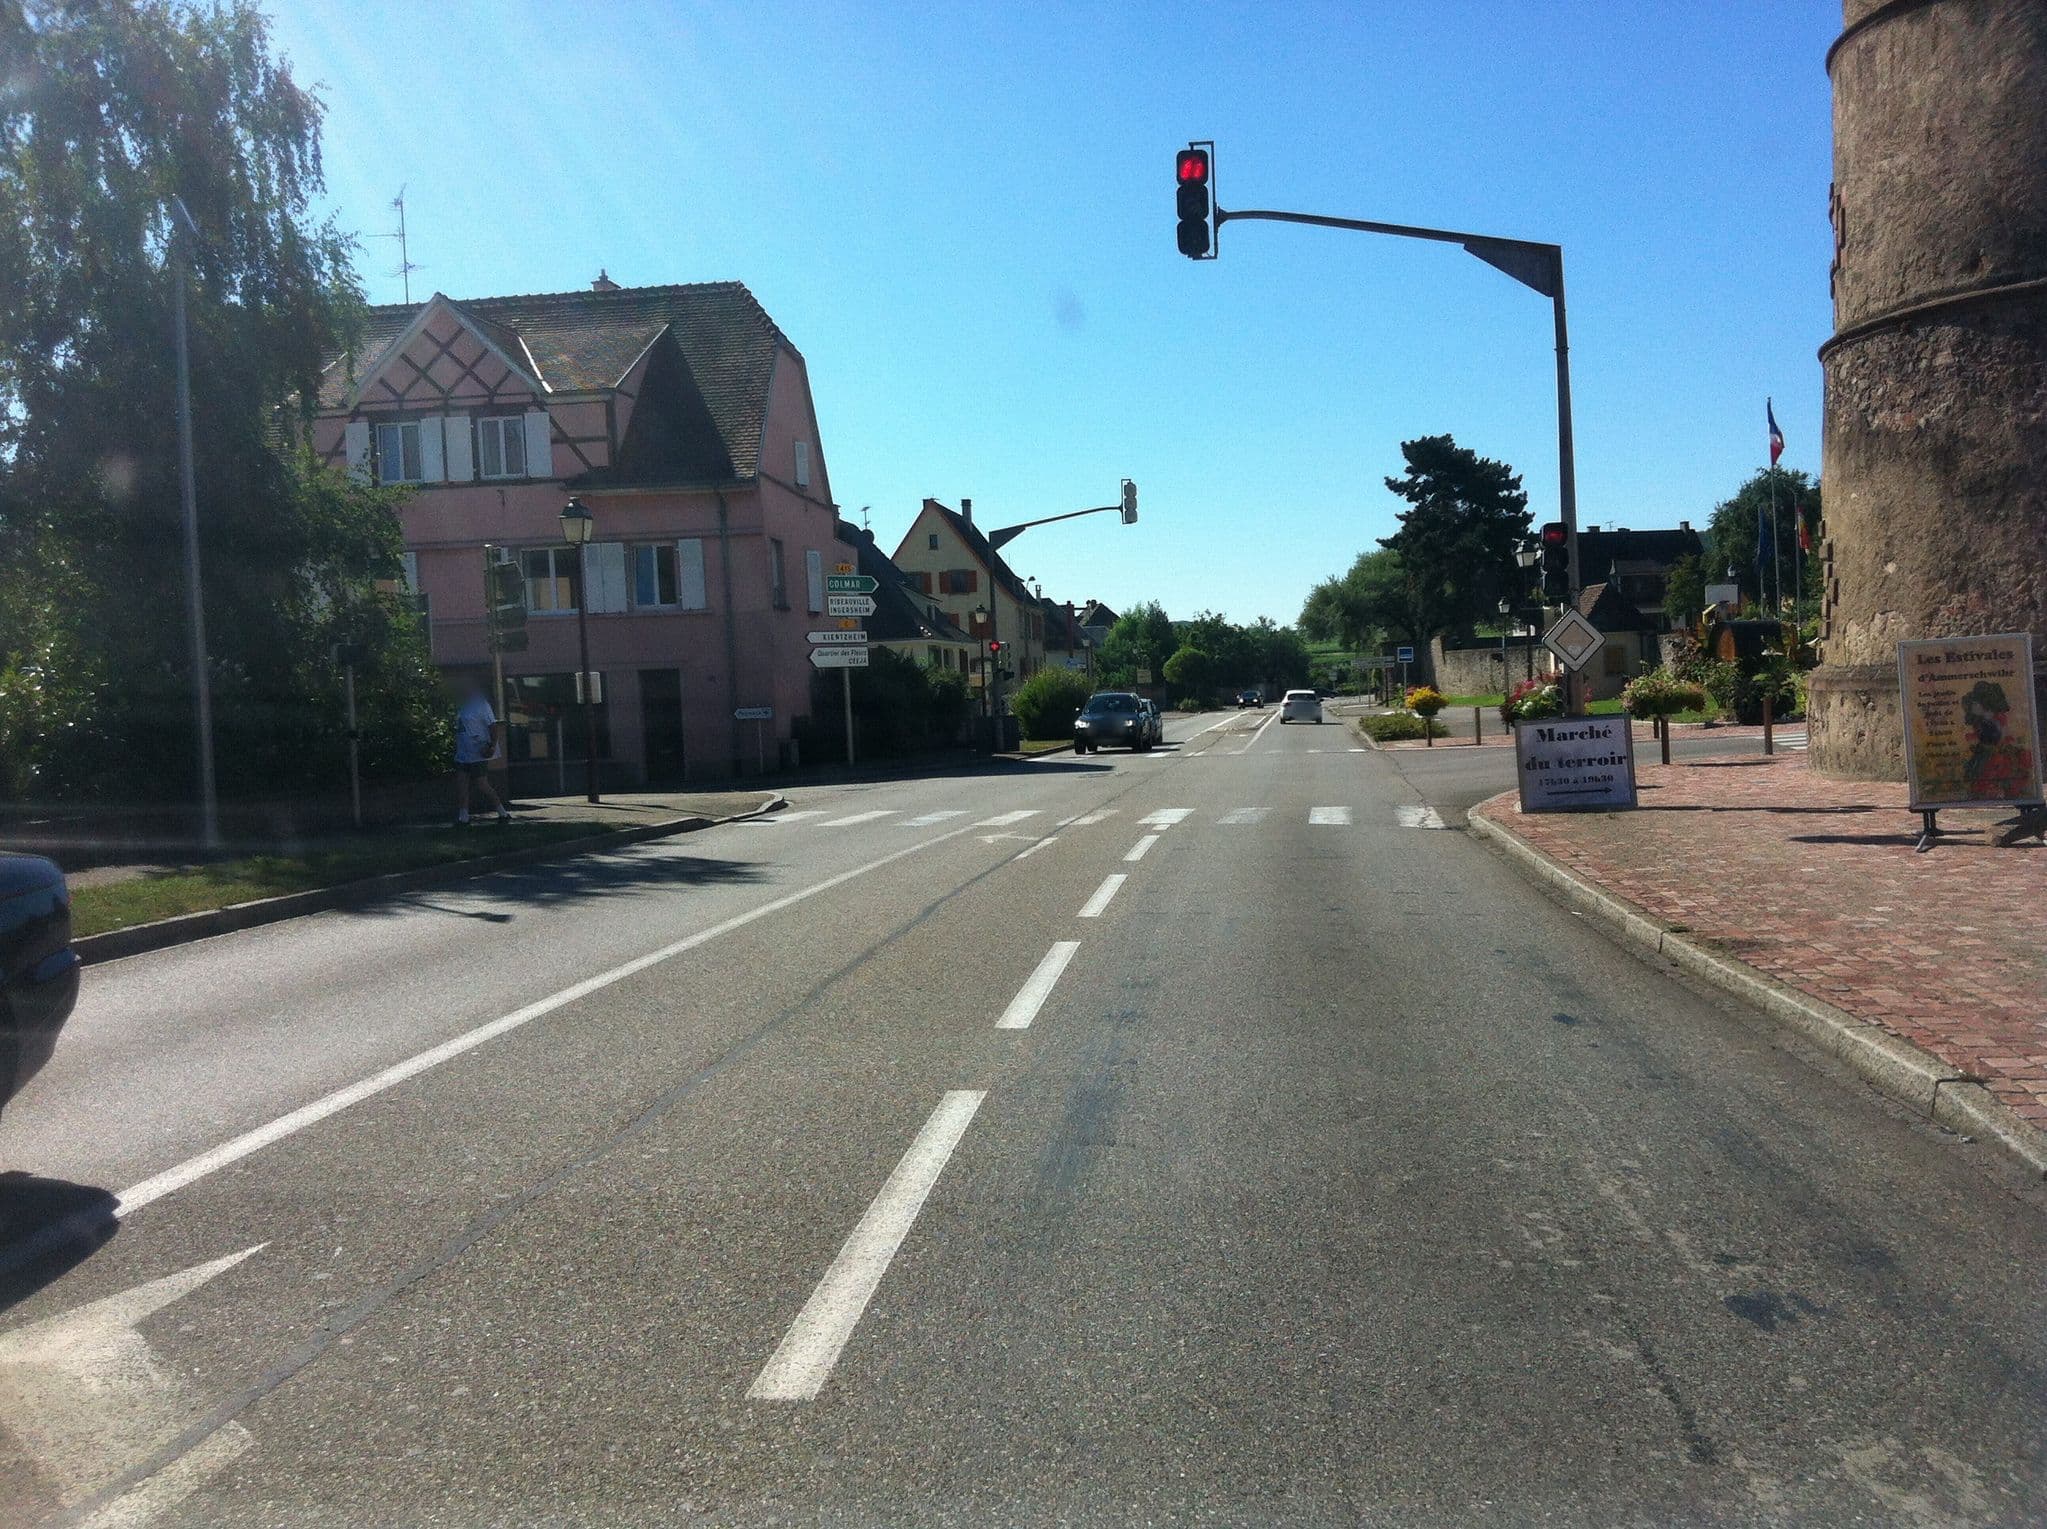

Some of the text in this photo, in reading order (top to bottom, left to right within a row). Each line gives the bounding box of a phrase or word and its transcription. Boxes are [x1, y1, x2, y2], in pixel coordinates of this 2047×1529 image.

[829, 580, 861, 589] COLMAR
[830, 606, 870, 614] INGERSHEIM
[823, 633, 866, 641] KIENTZHEIM
[1917, 649, 2015, 665] Les Estivales
[1536, 725, 1612, 742] Marché
[1525, 751, 1627, 770] du terroir
[1583, 774, 1614, 785] 19h30
